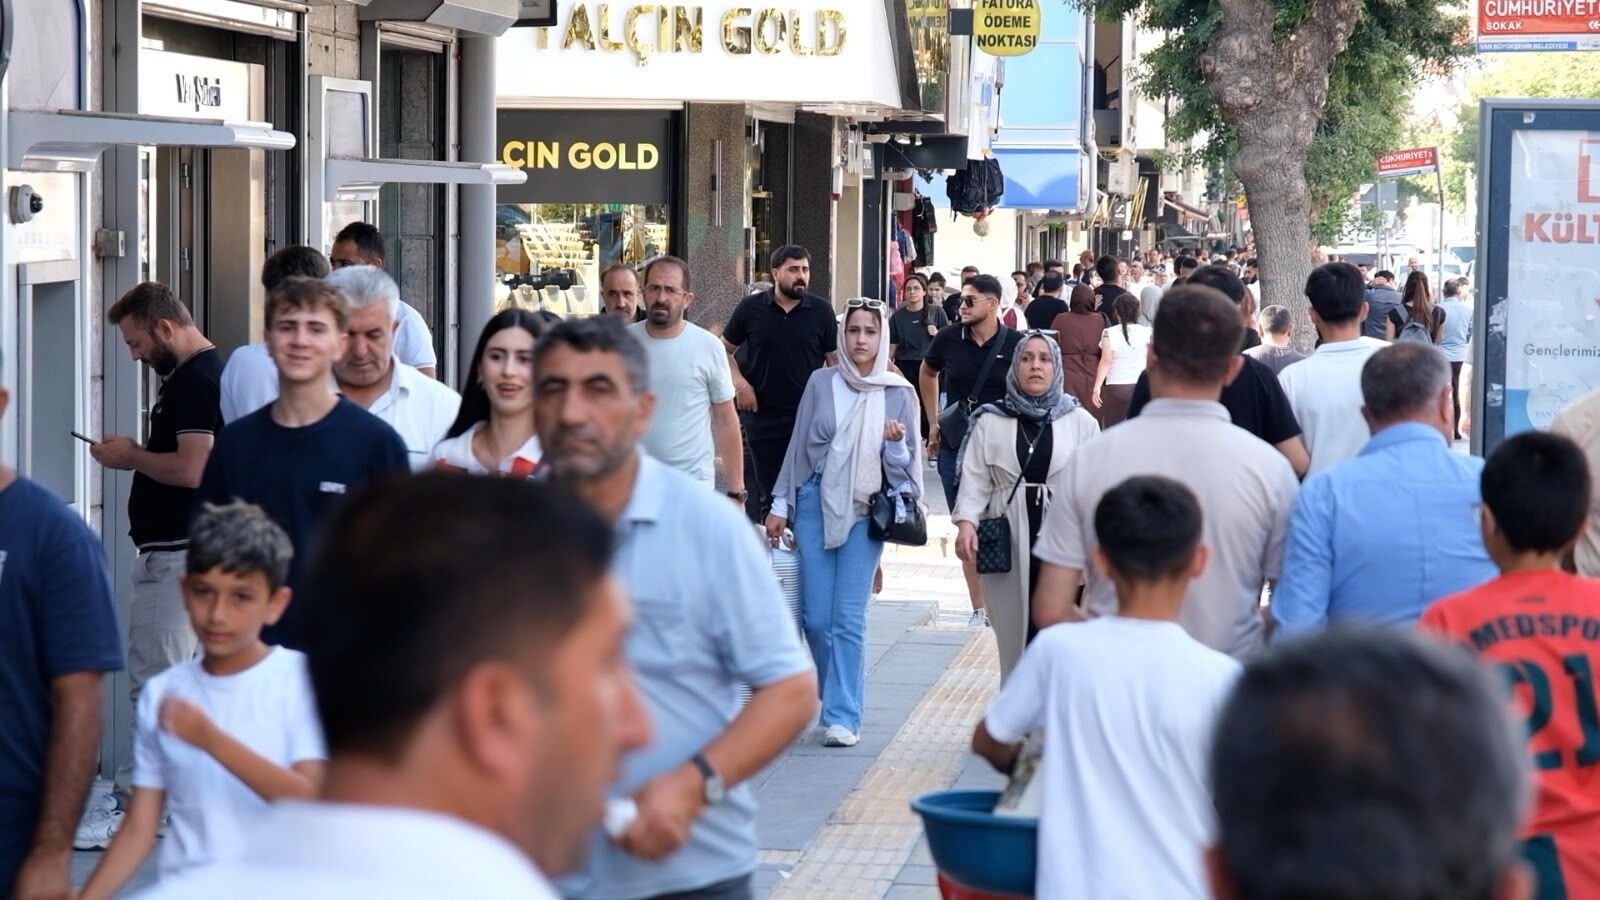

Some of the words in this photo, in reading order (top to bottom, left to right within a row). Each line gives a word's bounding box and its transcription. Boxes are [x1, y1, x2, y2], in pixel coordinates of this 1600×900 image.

[982, 0, 1034, 9] FATURA
[984, 12, 1031, 28] ÖDEME
[1486, 22, 1522, 31] SOKAK
[720, 6, 847, 57] GOLD
[977, 34, 1037, 48] NOKTASI
[568, 142, 659, 171] GOLD
